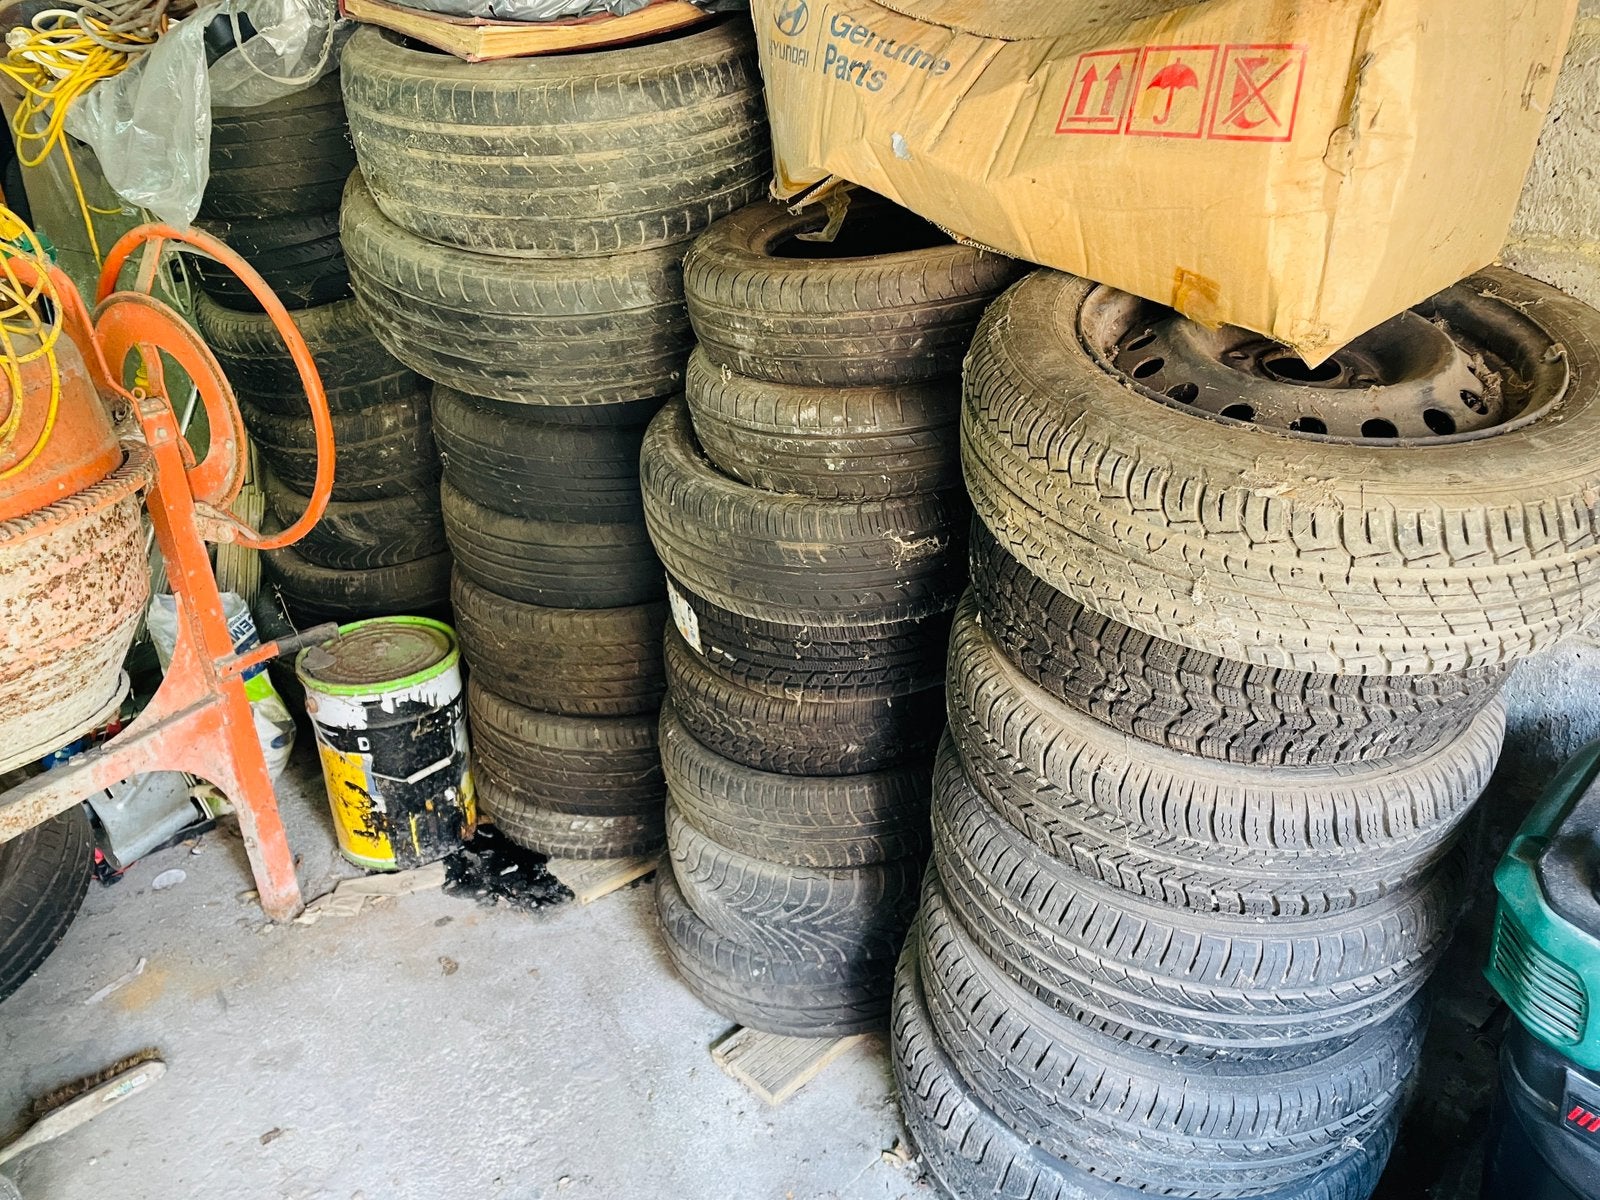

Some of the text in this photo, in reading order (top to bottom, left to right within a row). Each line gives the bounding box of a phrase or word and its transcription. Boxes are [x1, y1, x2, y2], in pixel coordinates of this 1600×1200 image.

[768, 38, 809, 68] HYUNDAI
[823, 43, 888, 92] Parts
[830, 14, 951, 76] Genuine
